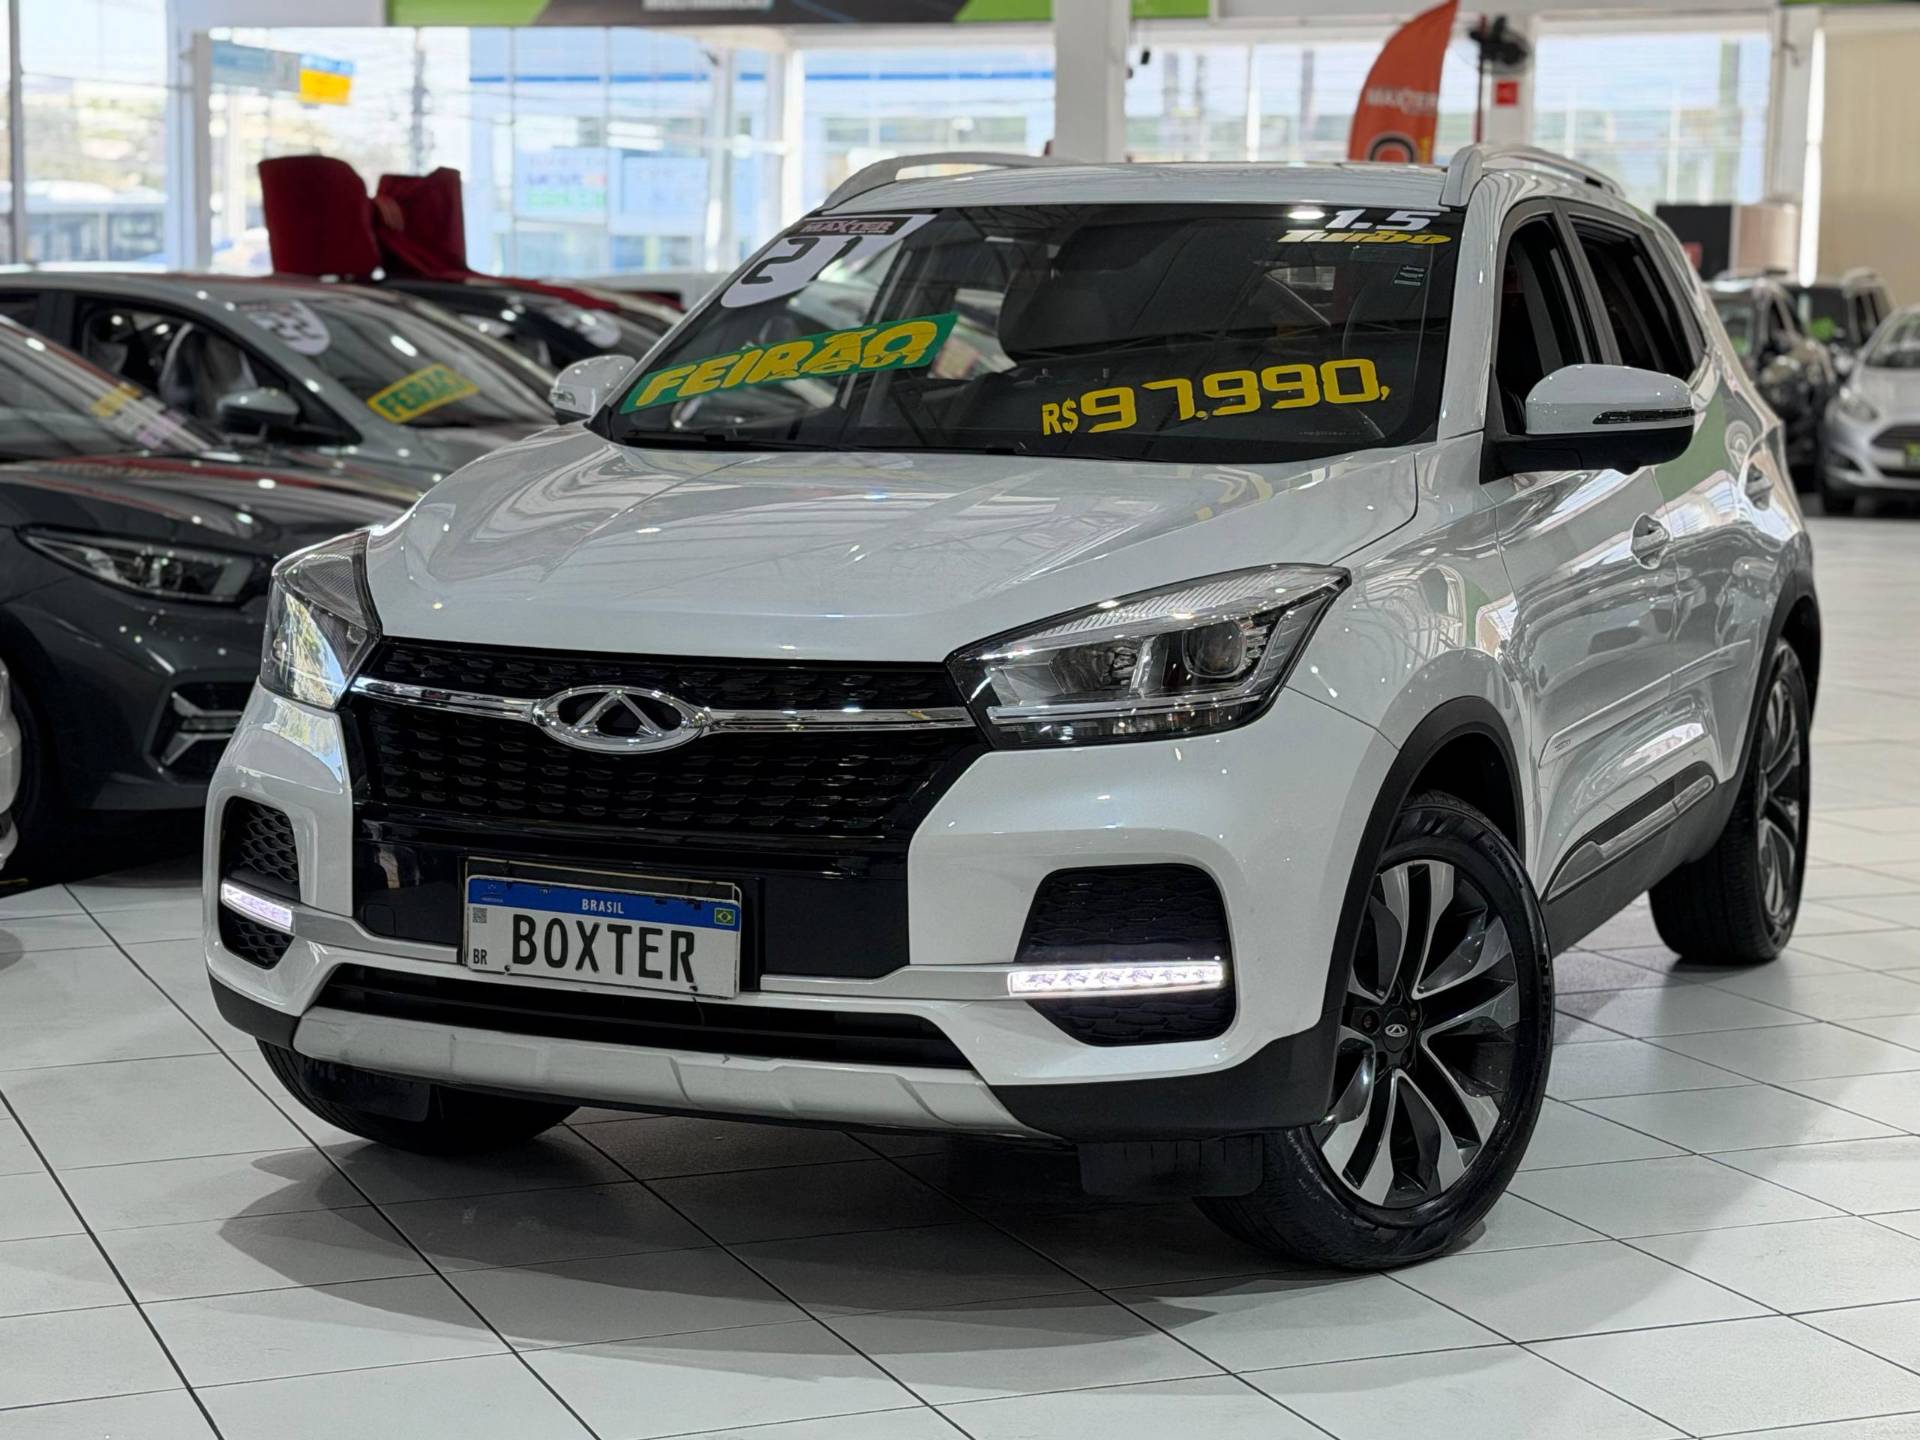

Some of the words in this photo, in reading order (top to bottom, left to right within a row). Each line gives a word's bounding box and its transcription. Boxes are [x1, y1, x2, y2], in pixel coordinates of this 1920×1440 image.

[1325, 209, 1440, 231] 1.5
[581, 898, 625, 915] BRASIL
[472, 948, 488, 965] BR
[512, 914, 696, 983] BOXTER
